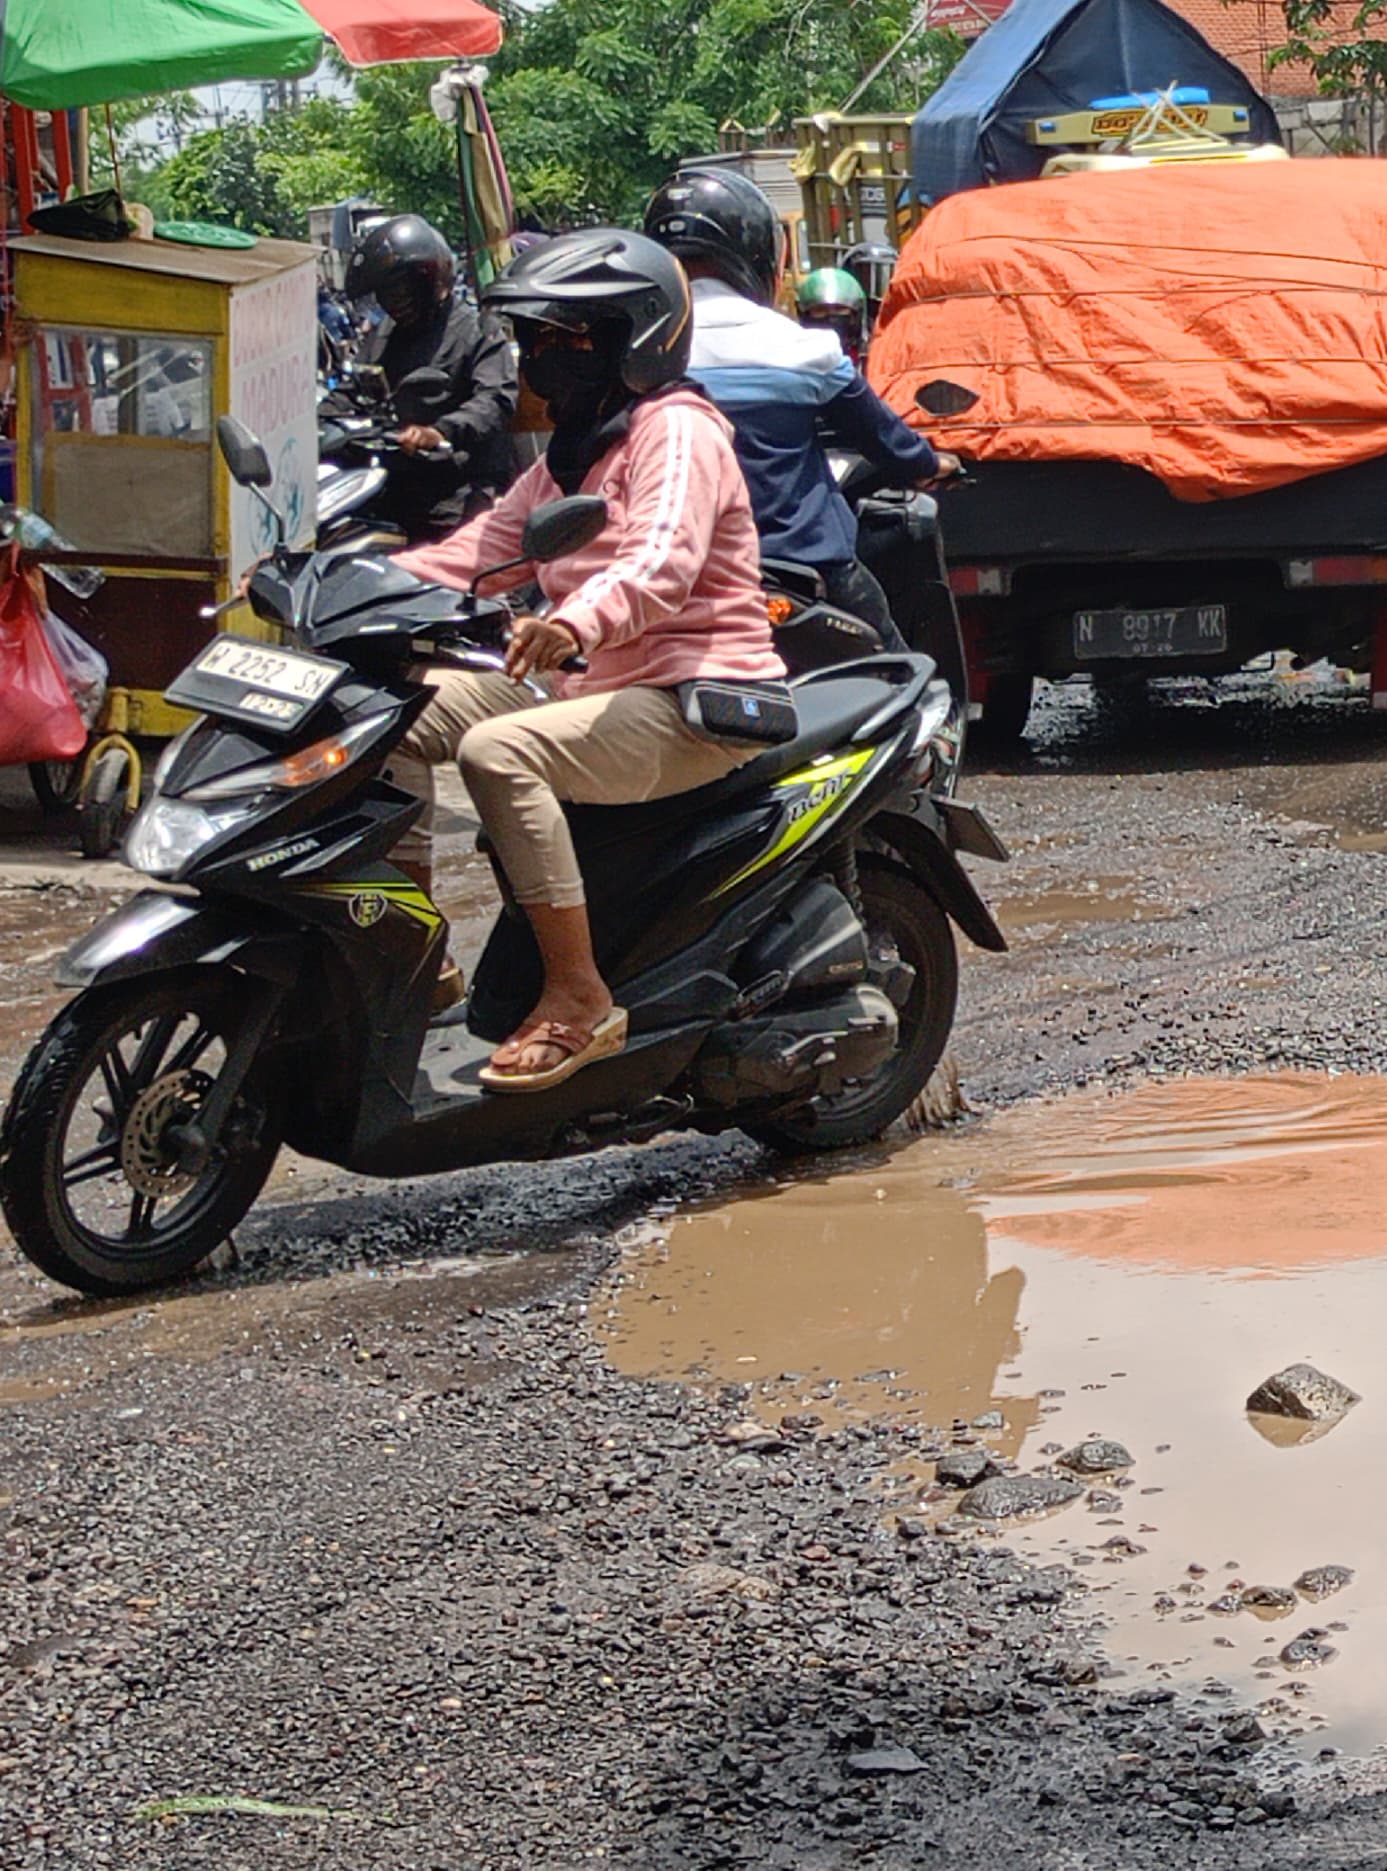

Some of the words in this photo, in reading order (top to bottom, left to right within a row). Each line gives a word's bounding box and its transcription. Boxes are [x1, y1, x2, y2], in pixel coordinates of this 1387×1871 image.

[1079, 615, 1094, 641] N
[1122, 612, 1177, 641] 8917
[1197, 609, 1221, 637] KK
[228, 651, 288, 684] 2252
[246, 837, 321, 872] HONDA
